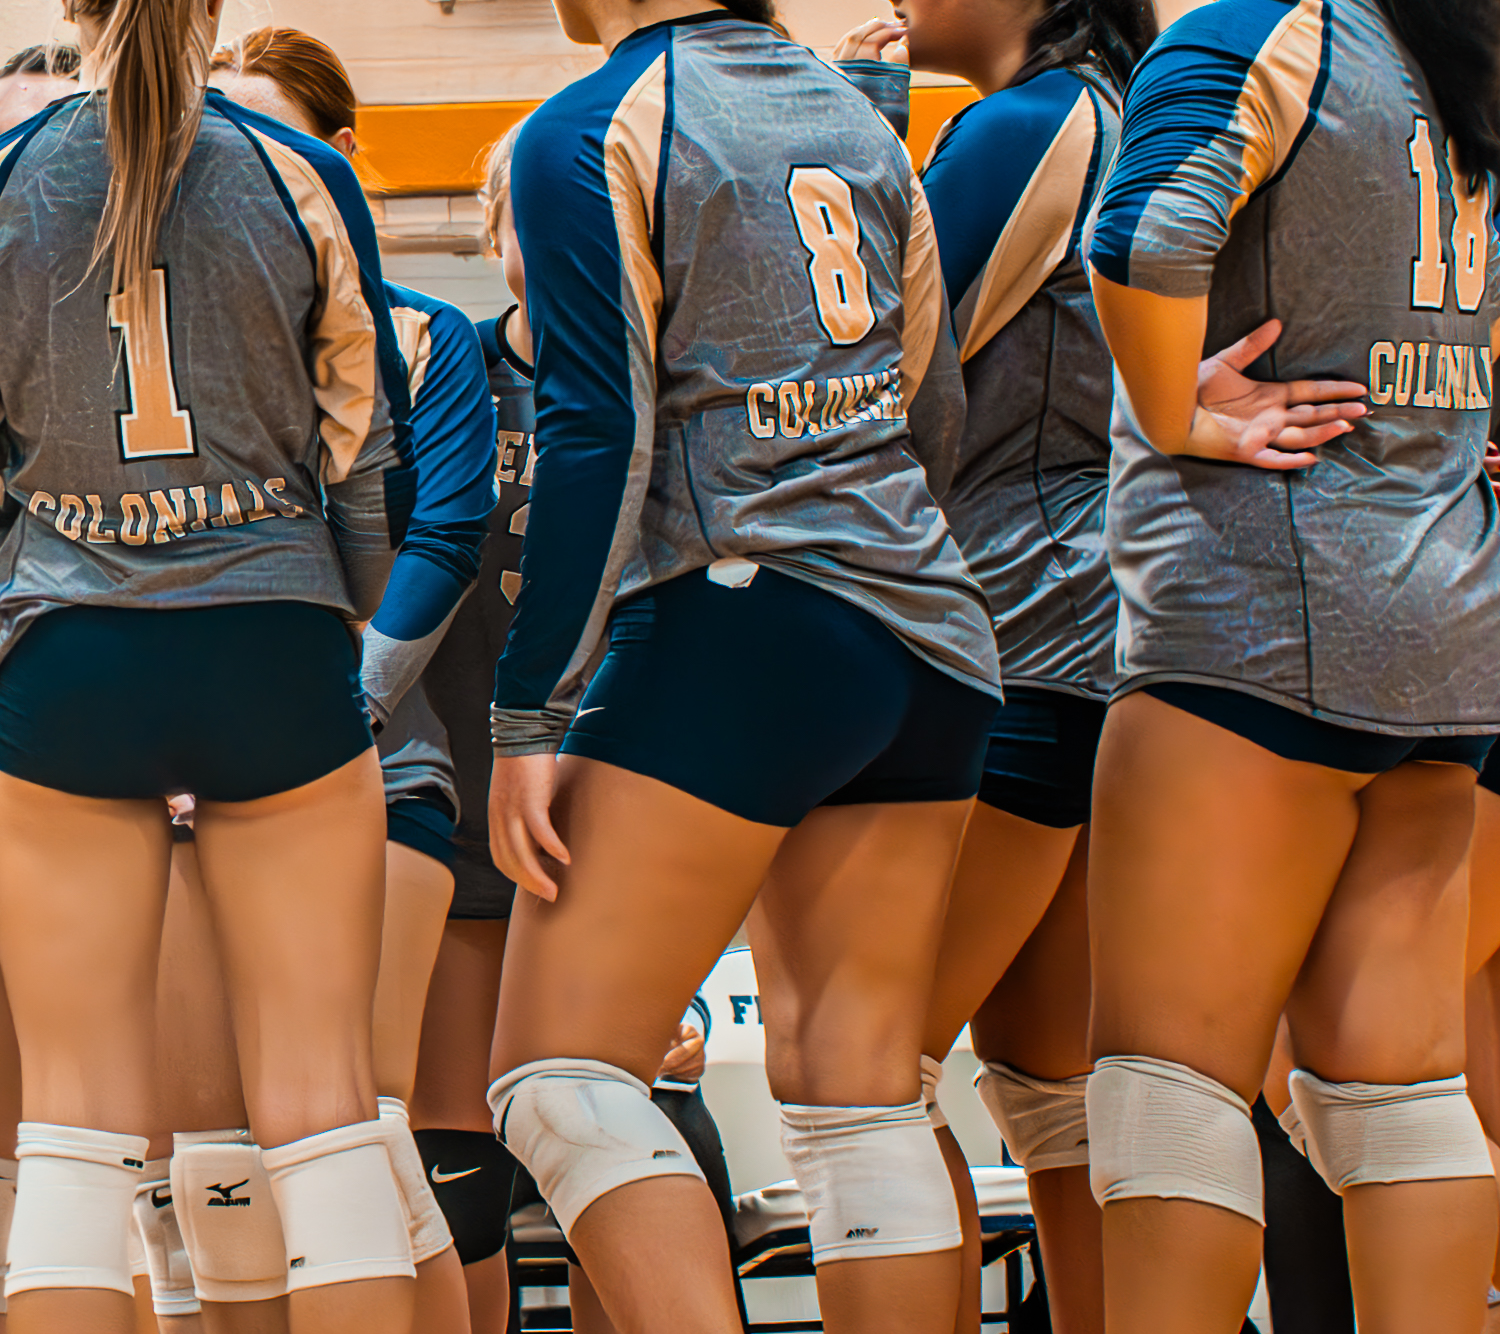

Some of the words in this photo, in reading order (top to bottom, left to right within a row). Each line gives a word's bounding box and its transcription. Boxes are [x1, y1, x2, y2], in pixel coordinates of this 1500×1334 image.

[785, 164, 878, 348] 8
[105, 265, 198, 463] 1
[27, 477, 304, 546] COLONIALS
